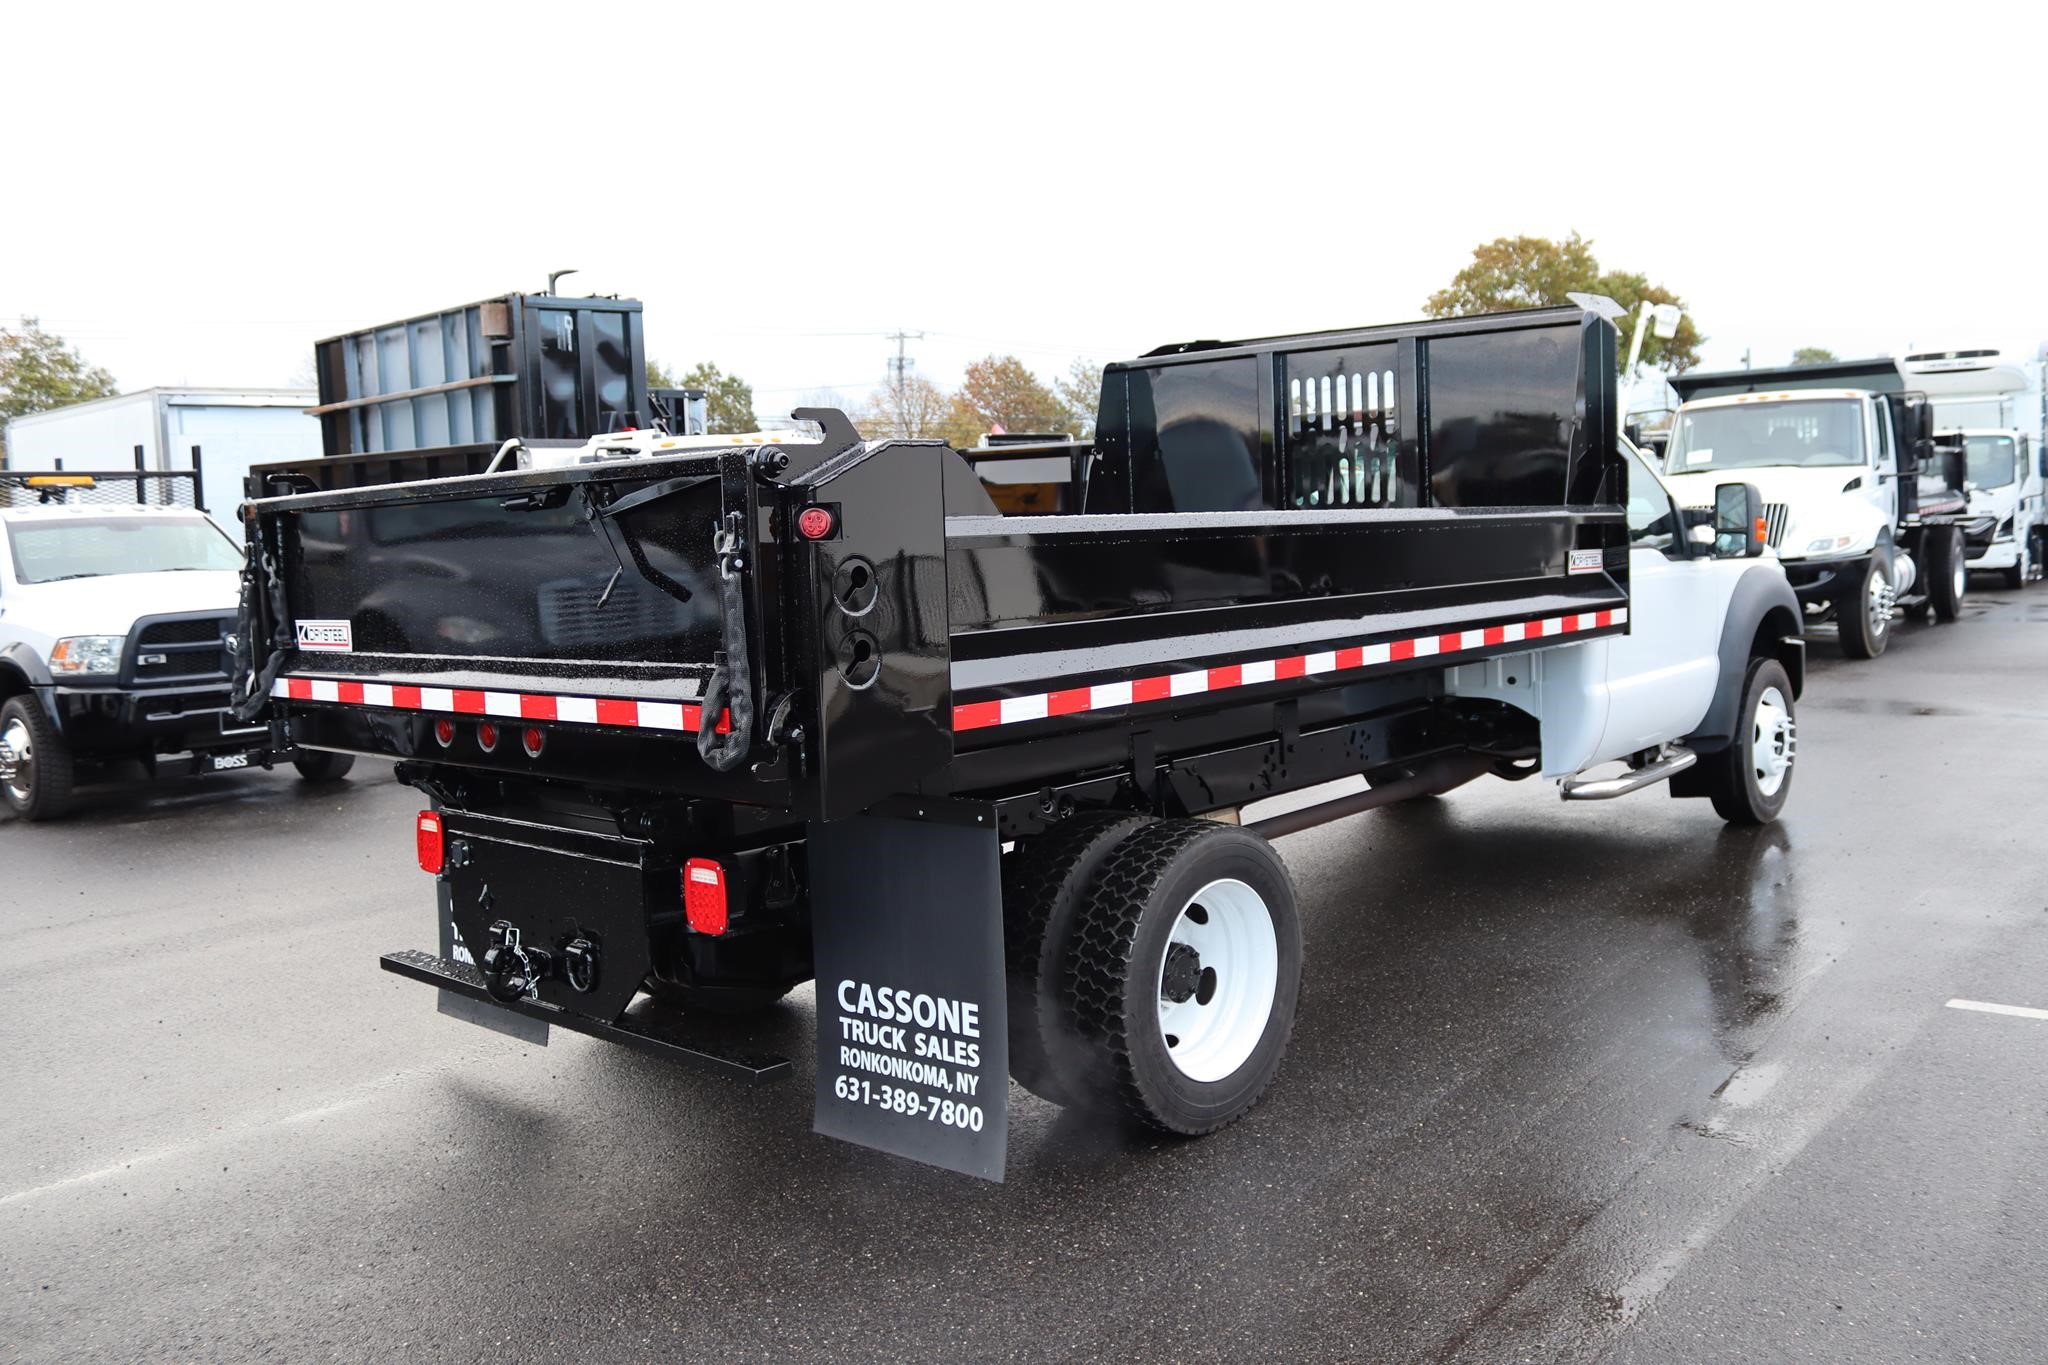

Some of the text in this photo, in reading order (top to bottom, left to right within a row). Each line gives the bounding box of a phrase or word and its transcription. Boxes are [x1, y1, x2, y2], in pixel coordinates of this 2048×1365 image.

[214, 754, 248, 769] BOSS
[837, 979, 980, 1038] CASSONE
[839, 1016, 981, 1068] TRUCK SALES
[840, 1045, 980, 1096] RONKONKOMA, NY
[835, 1075, 984, 1132] 631-389-7800
